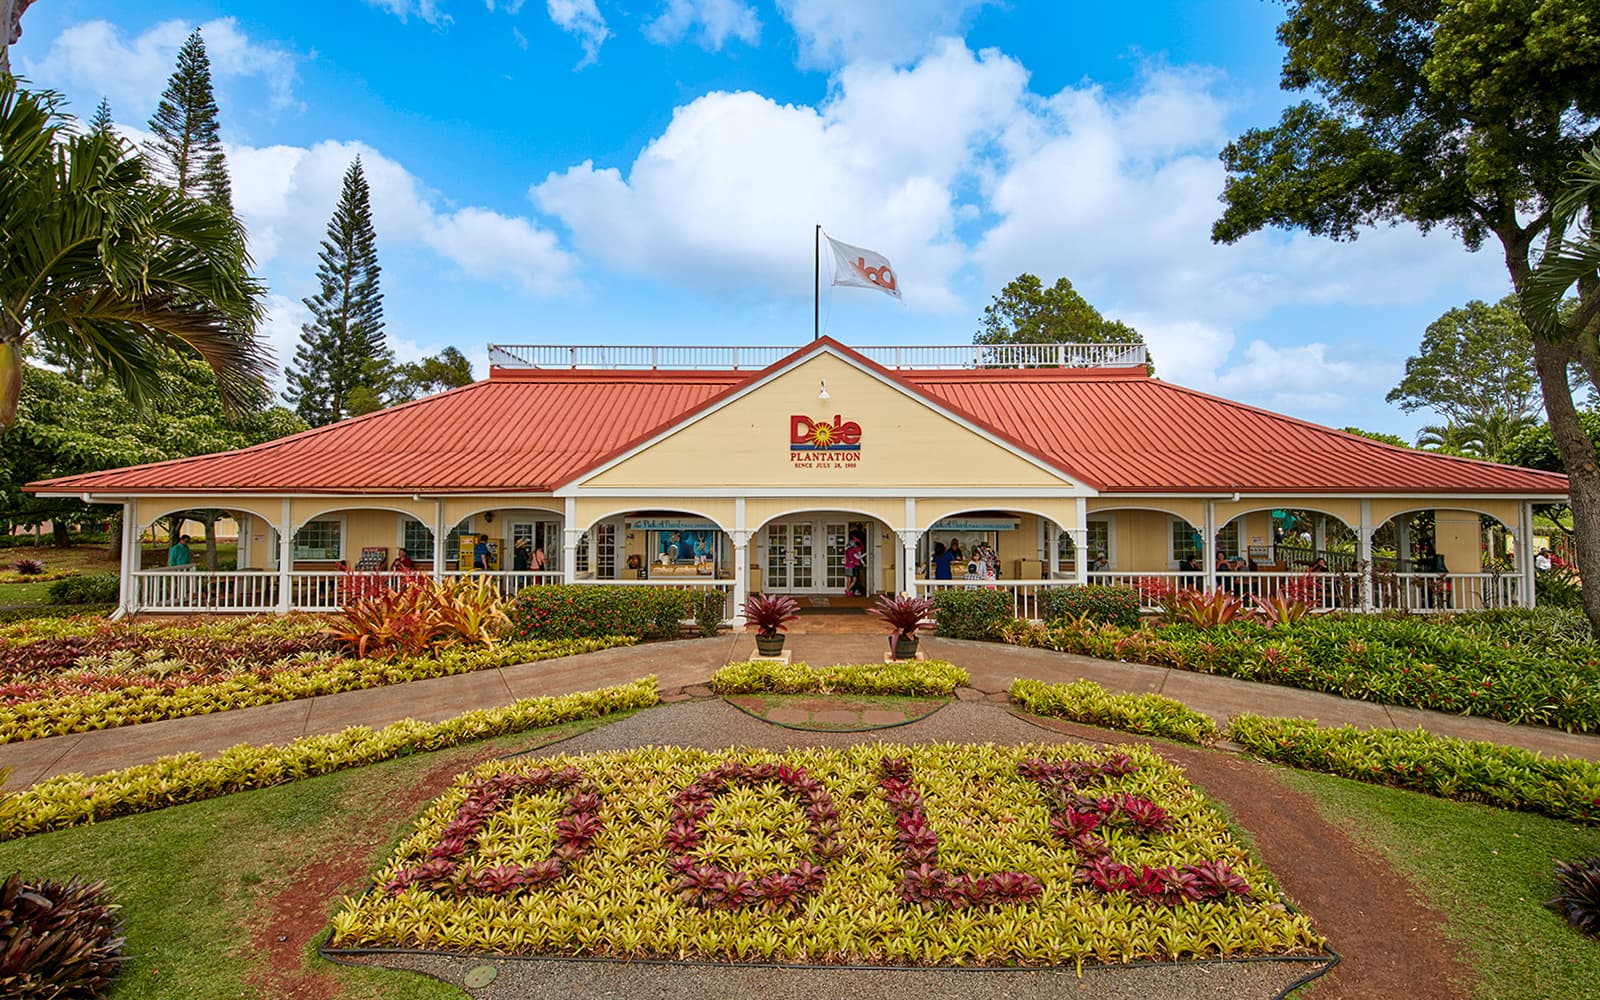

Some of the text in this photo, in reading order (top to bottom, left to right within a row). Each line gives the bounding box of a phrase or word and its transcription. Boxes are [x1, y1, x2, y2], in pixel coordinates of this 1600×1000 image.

[790, 414, 862, 446] Dole
[790, 452, 861, 462] PLANTATION
[384, 756, 1251, 912] DOLE
